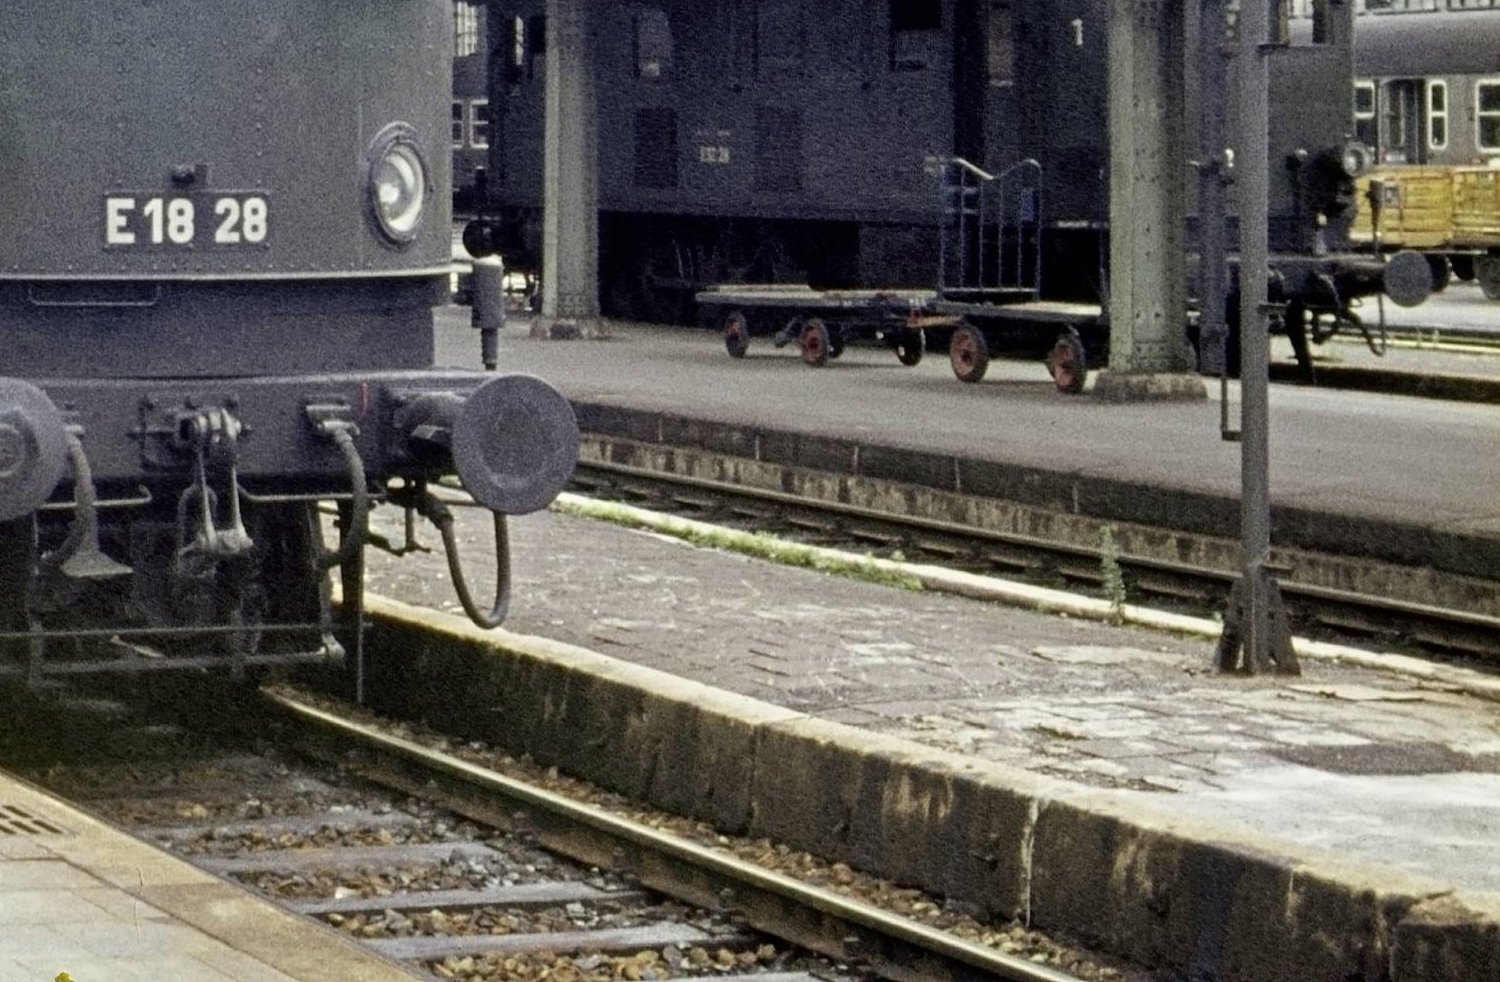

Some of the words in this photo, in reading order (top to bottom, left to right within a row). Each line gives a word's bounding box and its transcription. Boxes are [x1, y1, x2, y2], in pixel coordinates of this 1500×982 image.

[1071, 18, 1084, 45] 1
[106, 198, 135, 243] E
[143, 198, 195, 243] 18
[214, 197, 267, 243] 28
